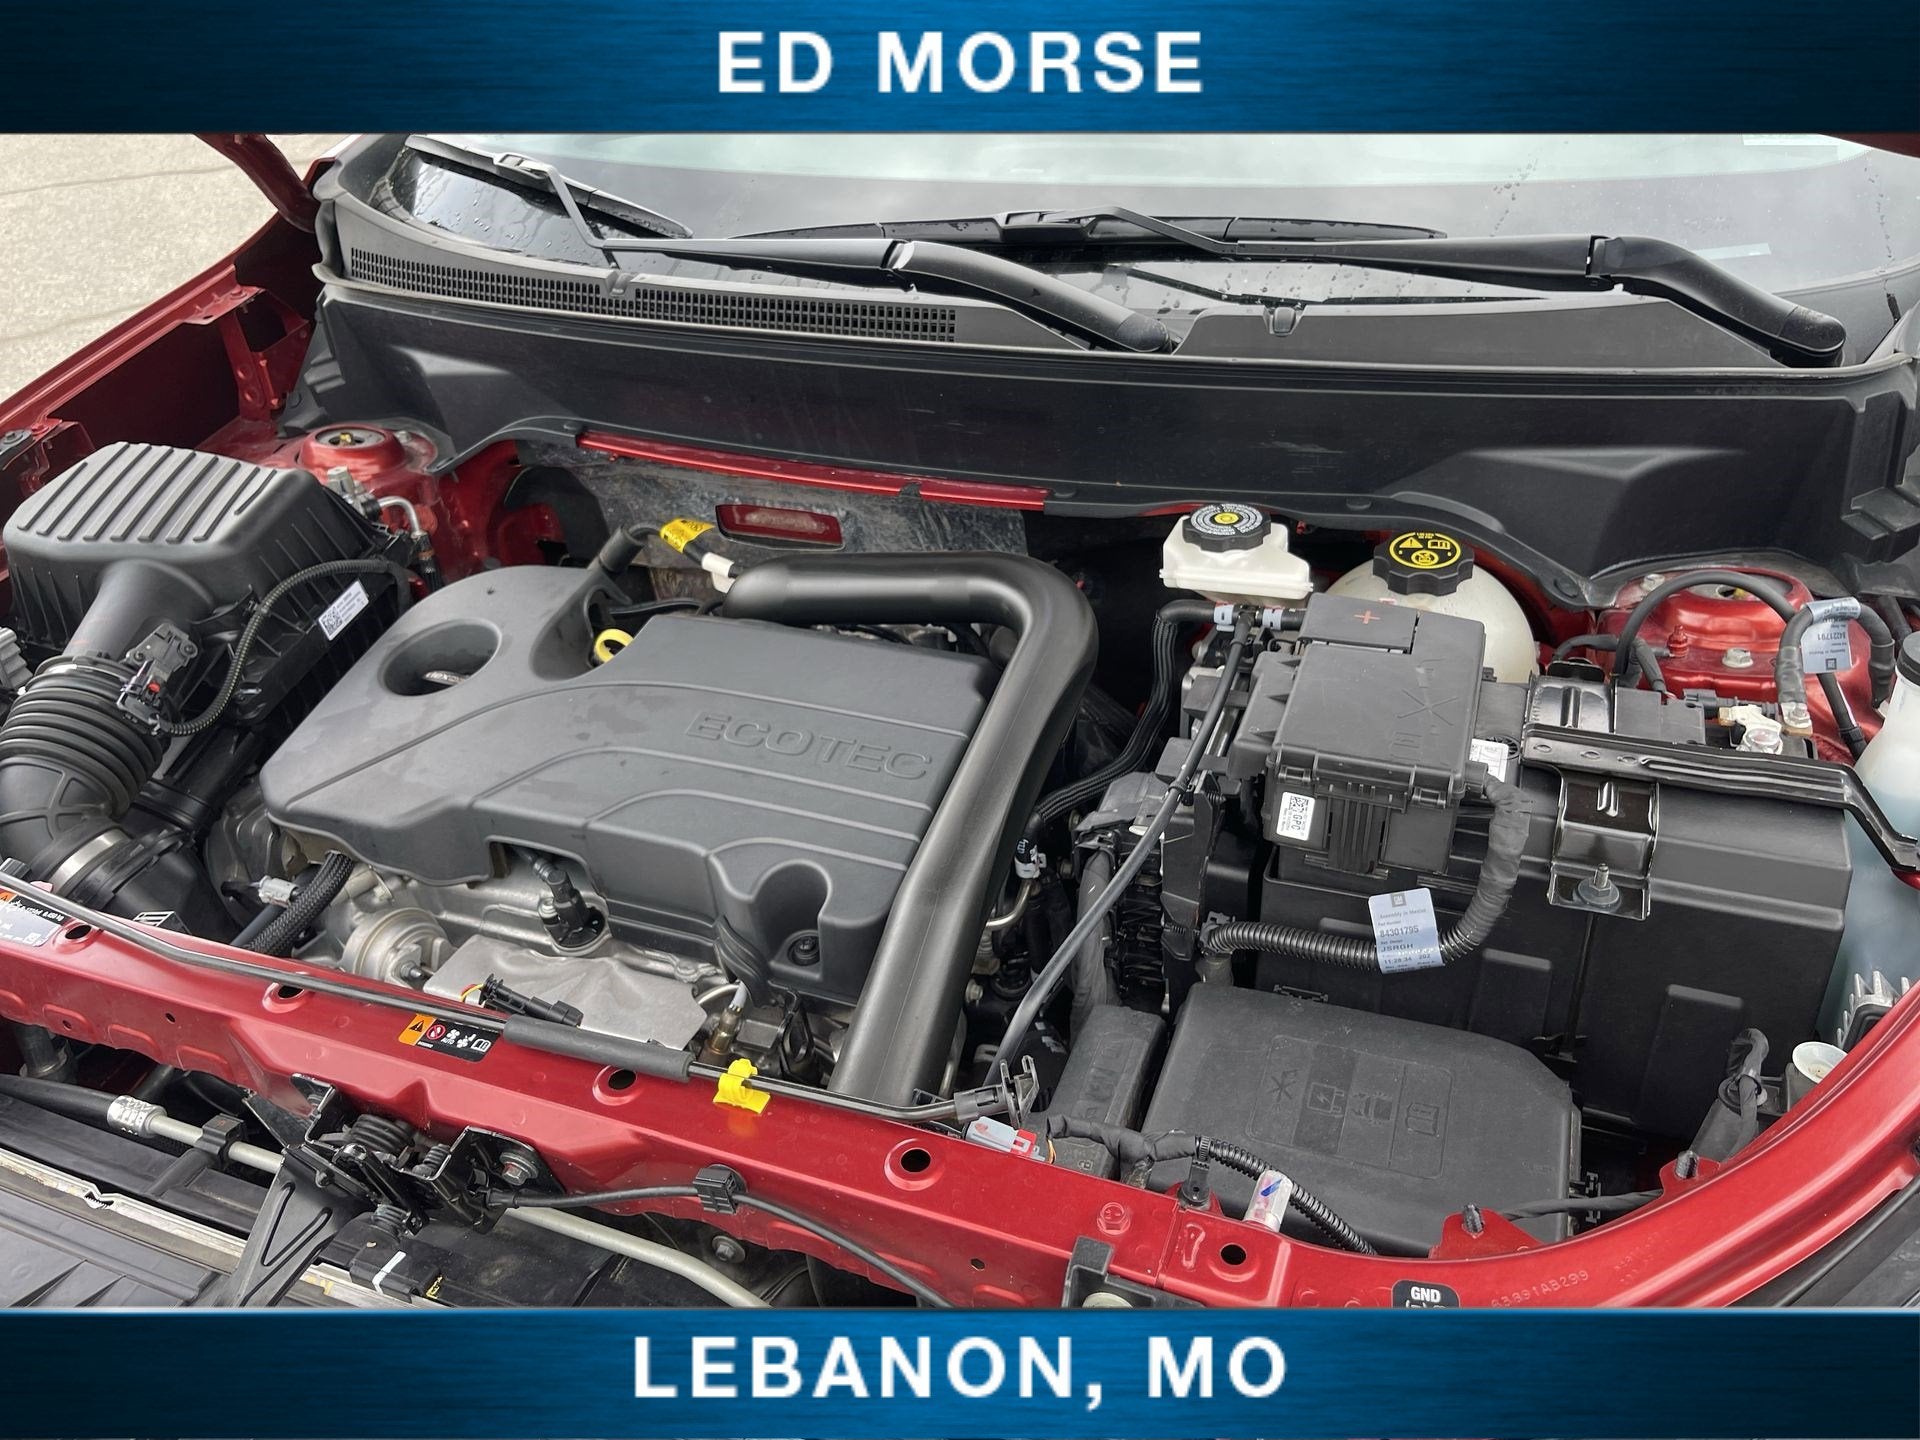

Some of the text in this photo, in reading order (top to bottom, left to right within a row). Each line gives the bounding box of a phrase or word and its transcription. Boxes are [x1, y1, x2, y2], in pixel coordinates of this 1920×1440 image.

[684, 710, 933, 780] ECOTEC
[1291, 814, 1303, 831] GPC
[1410, 1286, 1441, 1303] GND
